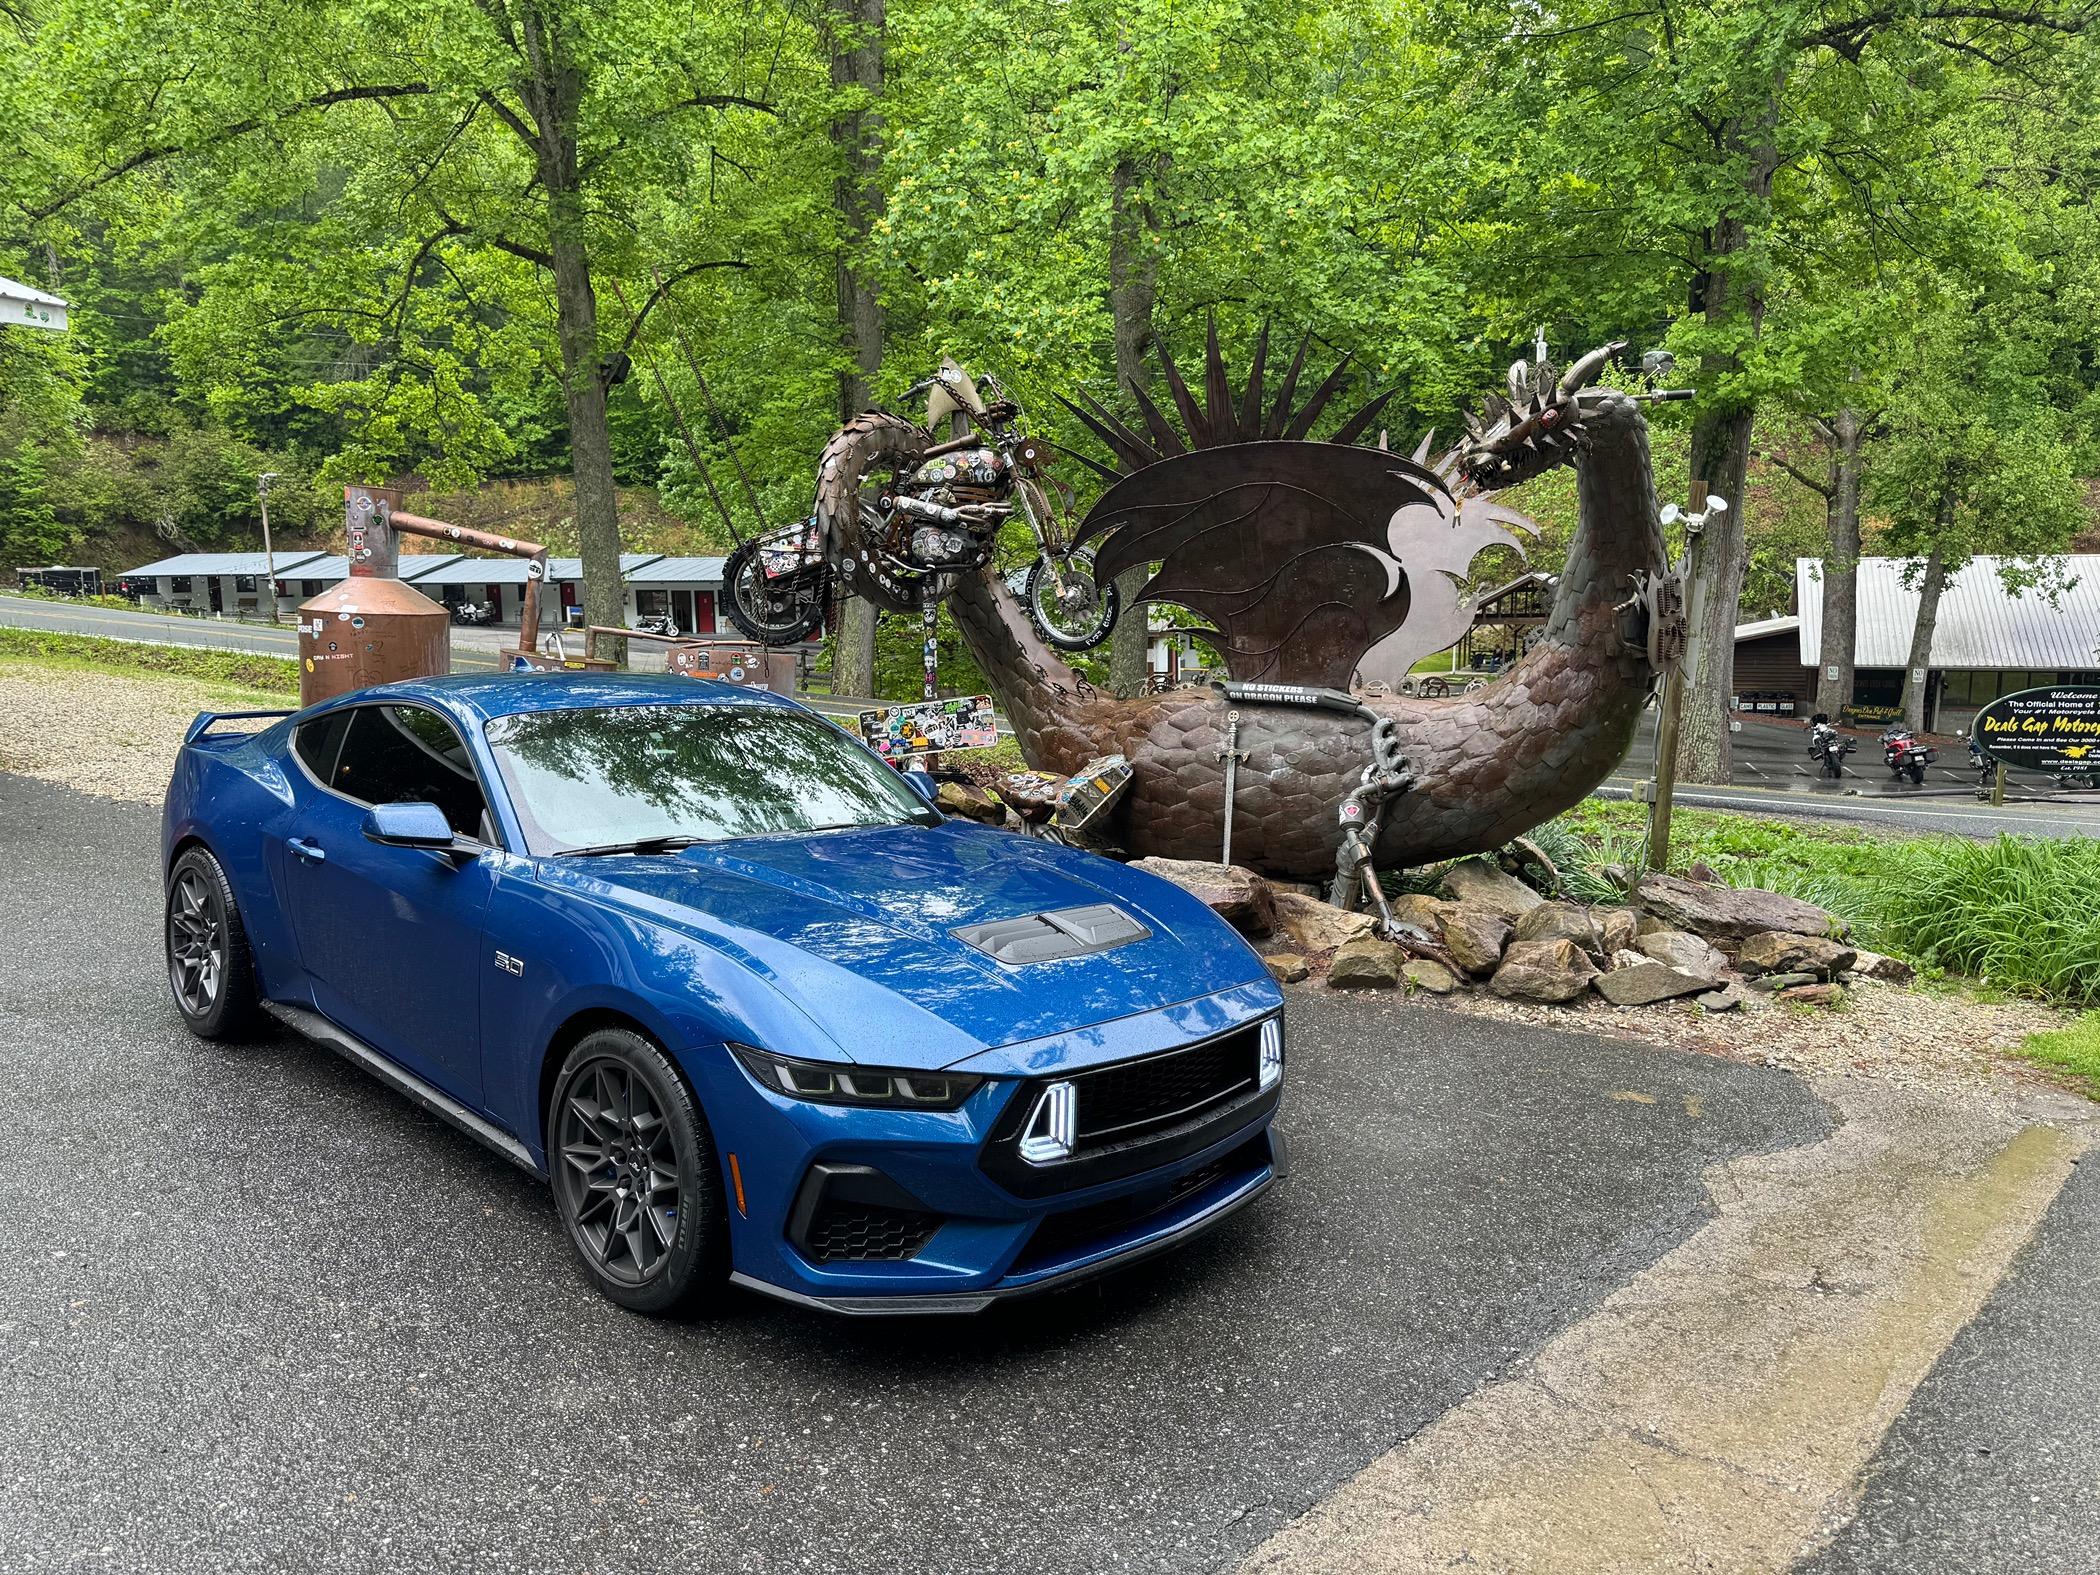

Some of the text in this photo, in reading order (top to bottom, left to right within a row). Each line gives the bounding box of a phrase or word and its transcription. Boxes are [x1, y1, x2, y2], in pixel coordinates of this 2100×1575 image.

[1242, 683, 1304, 694] NO STICKERS
[1244, 692, 1282, 702] DRAGON
[1284, 694, 1318, 704] PLEASE
[2050, 691, 2098, 699] Welcome
[2026, 700, 2056, 708] Official
[1984, 716, 2019, 732] Deals
[2021, 716, 2049, 737] Gap
